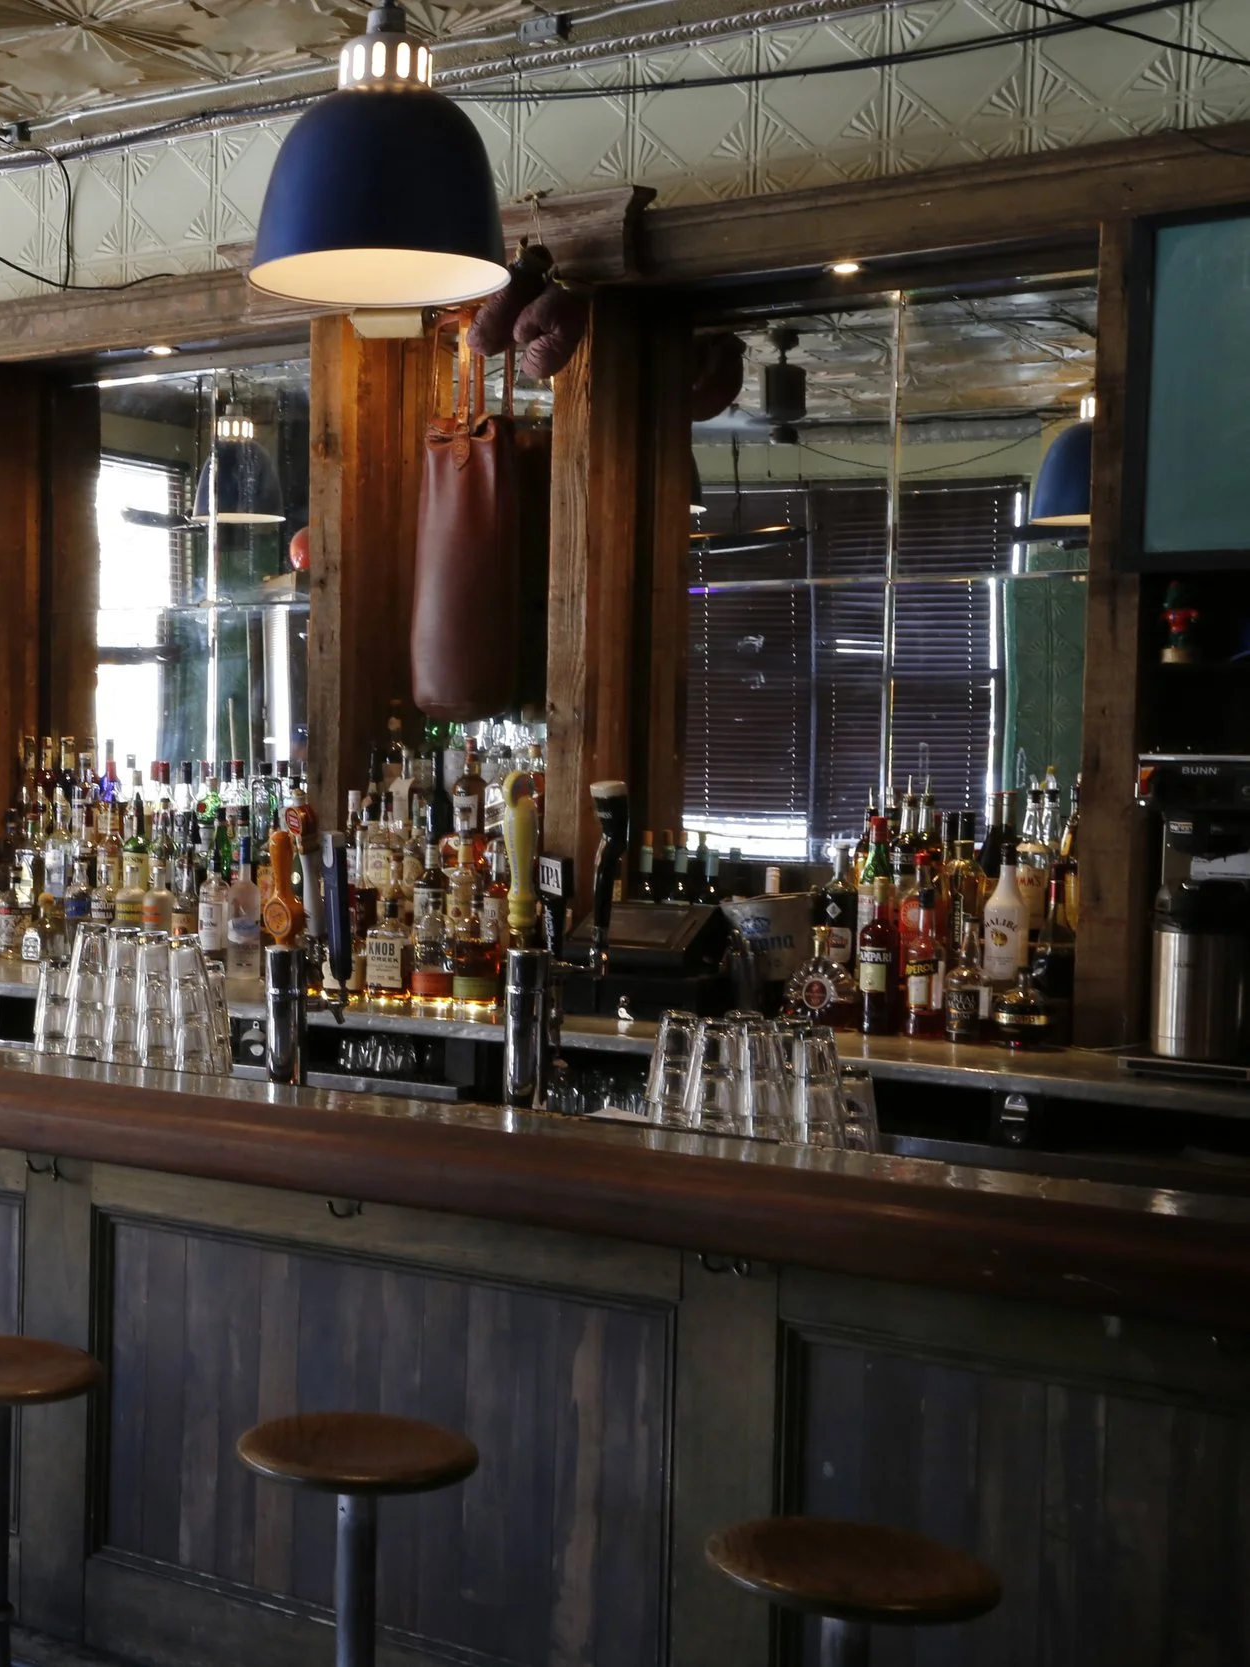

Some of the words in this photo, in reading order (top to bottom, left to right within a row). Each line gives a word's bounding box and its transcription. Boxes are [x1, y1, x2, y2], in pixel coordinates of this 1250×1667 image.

[1181, 765, 1218, 775] BUNN
[540, 865, 561, 888] IPA
[368, 941, 395, 956] KNOB
[859, 951, 892, 962] AMPARI
